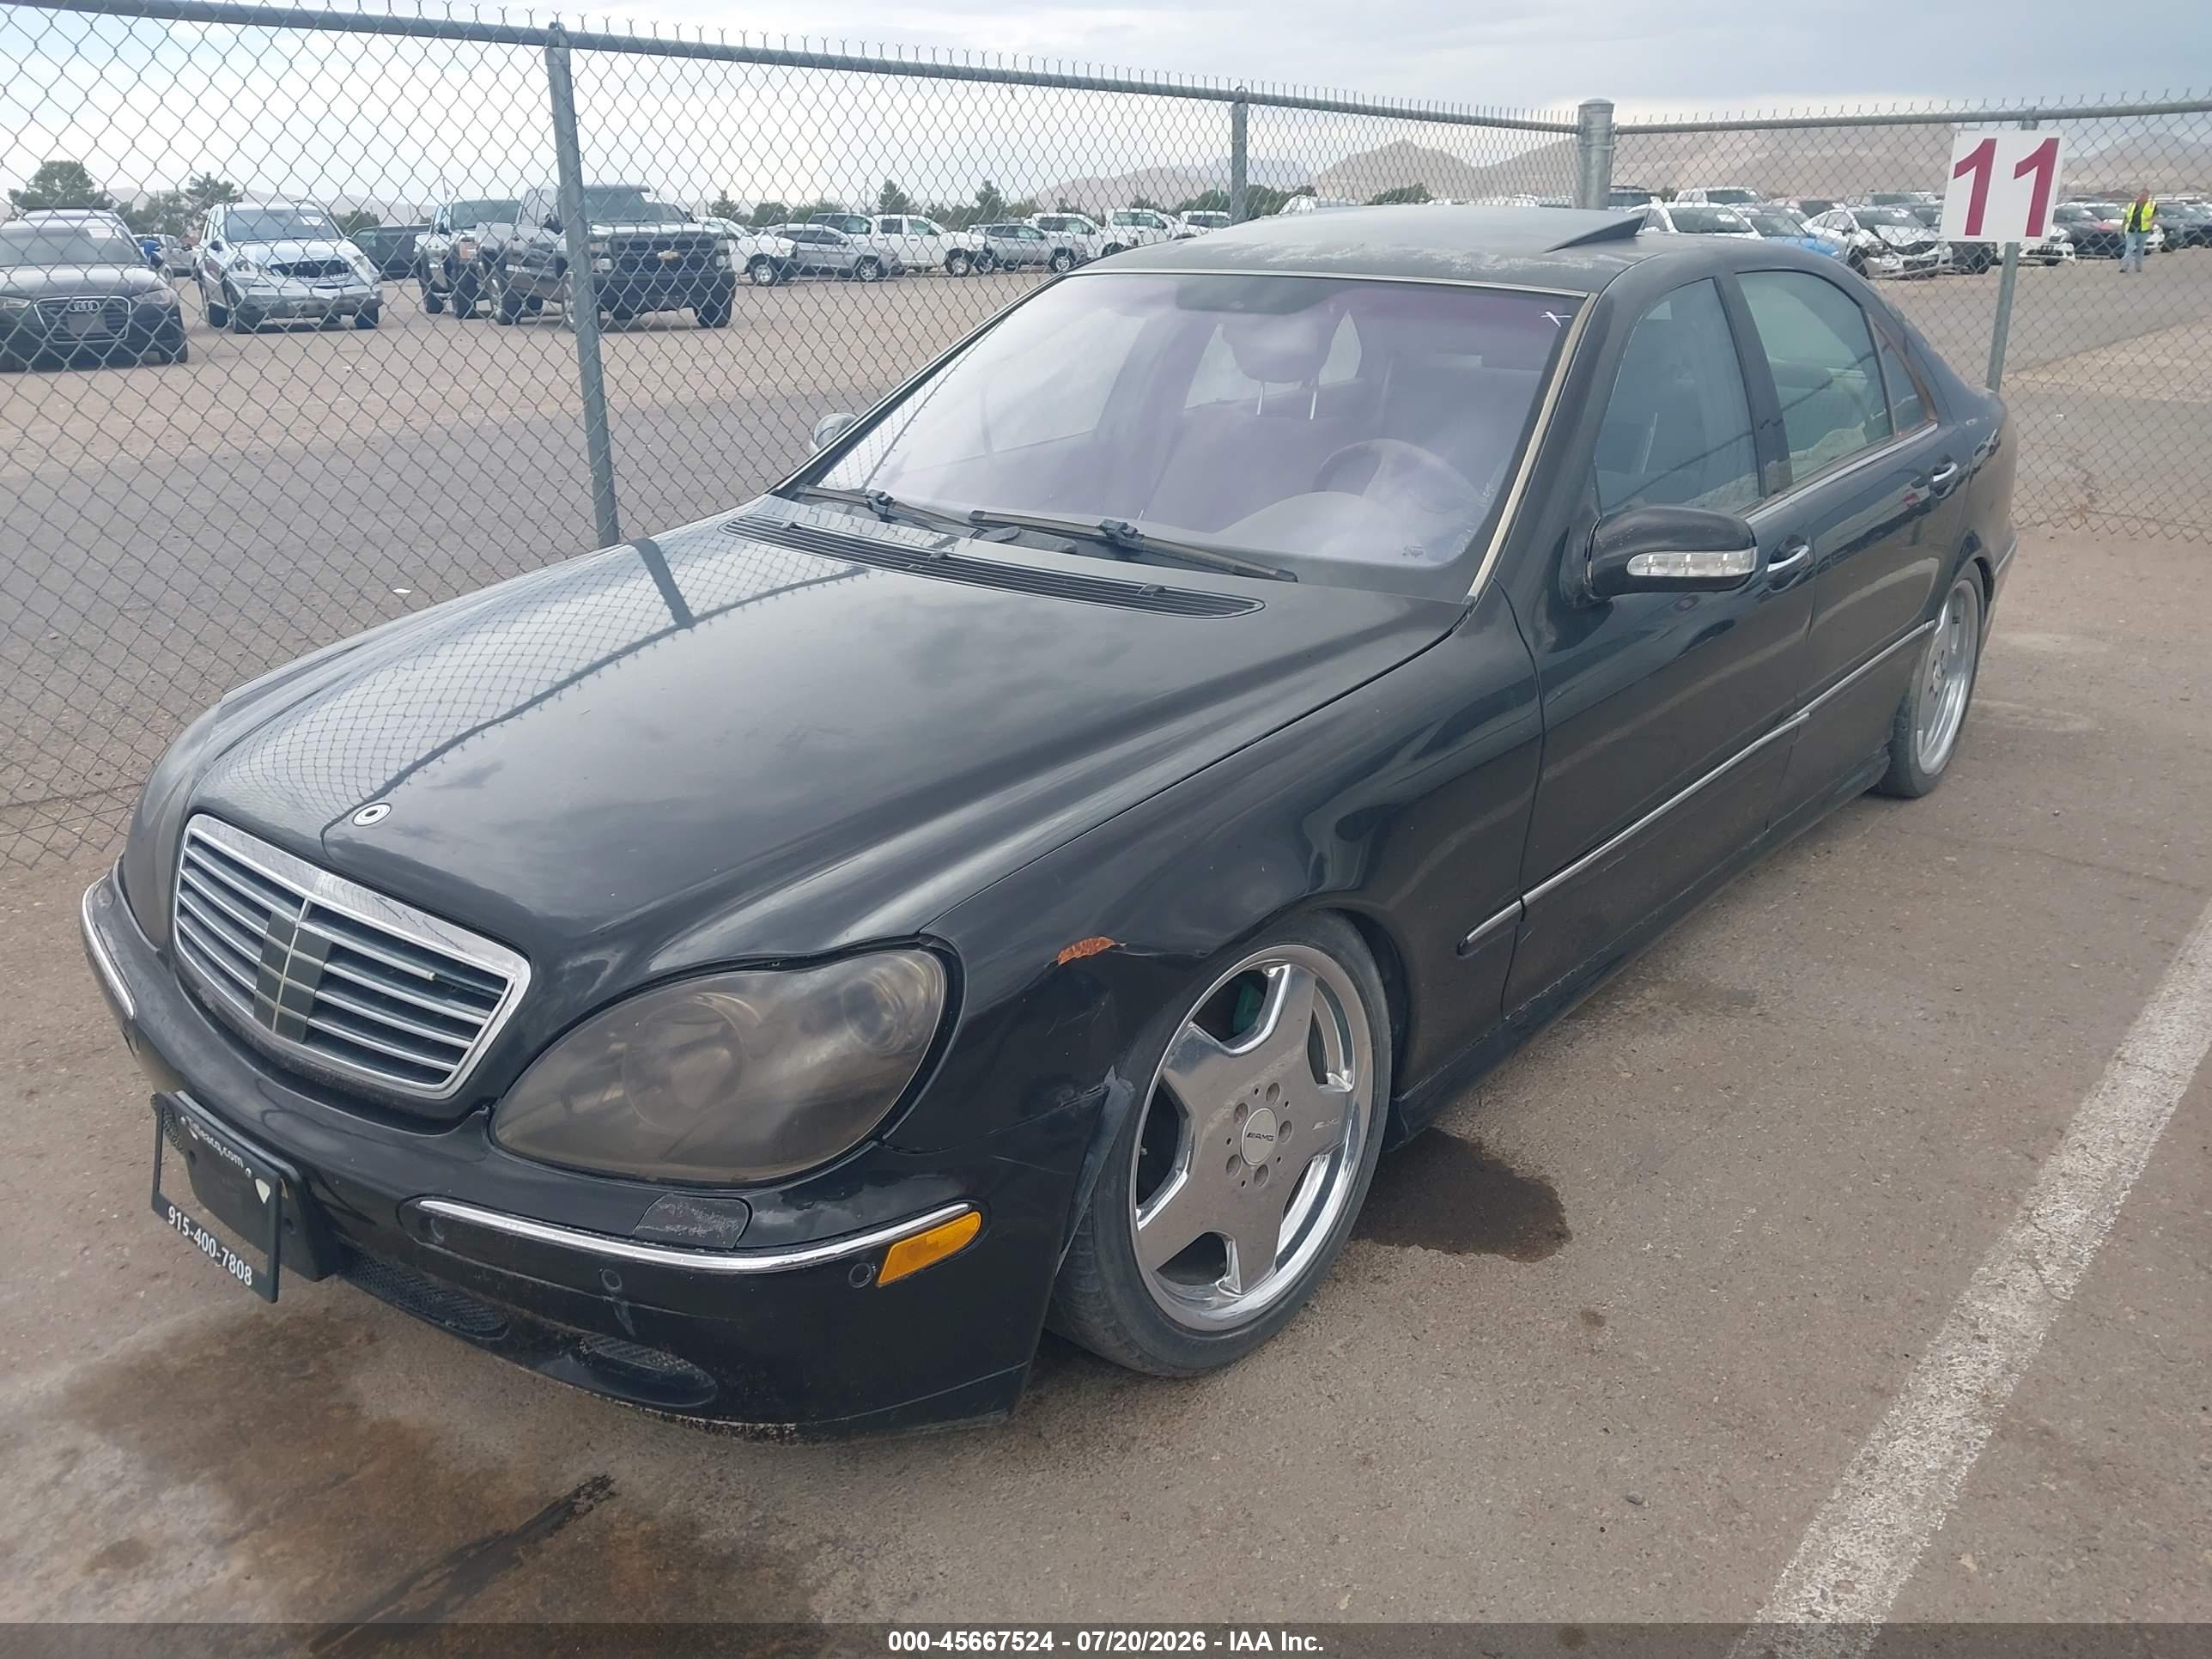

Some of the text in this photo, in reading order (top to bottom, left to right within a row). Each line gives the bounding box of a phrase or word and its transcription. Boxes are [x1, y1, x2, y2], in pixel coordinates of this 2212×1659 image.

[1953, 137, 2061, 238] 11
[1254, 1132, 1275, 1142] AMG
[167, 1205, 253, 1286] 915-400-7808
